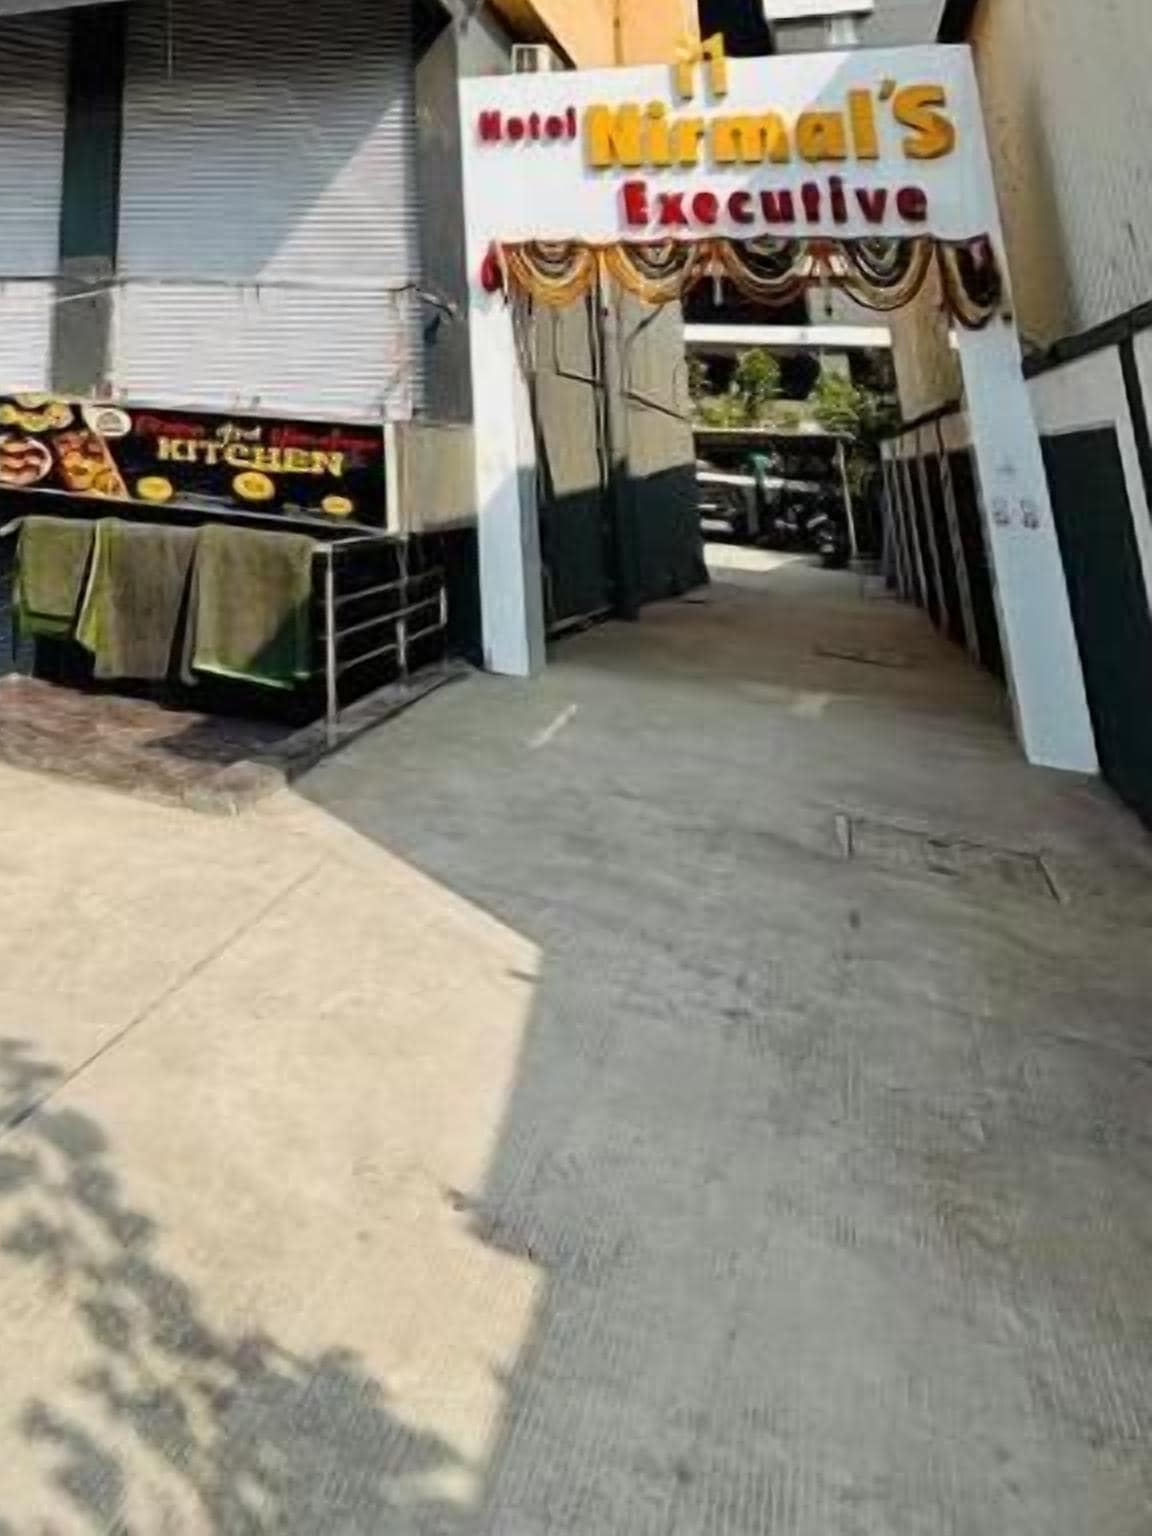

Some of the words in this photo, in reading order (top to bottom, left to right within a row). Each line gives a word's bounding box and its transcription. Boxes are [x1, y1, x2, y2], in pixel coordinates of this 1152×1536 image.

[478, 106, 577, 141] Hotel
[618, 174, 929, 228] Executive
[157, 436, 345, 477] KITCHEN
